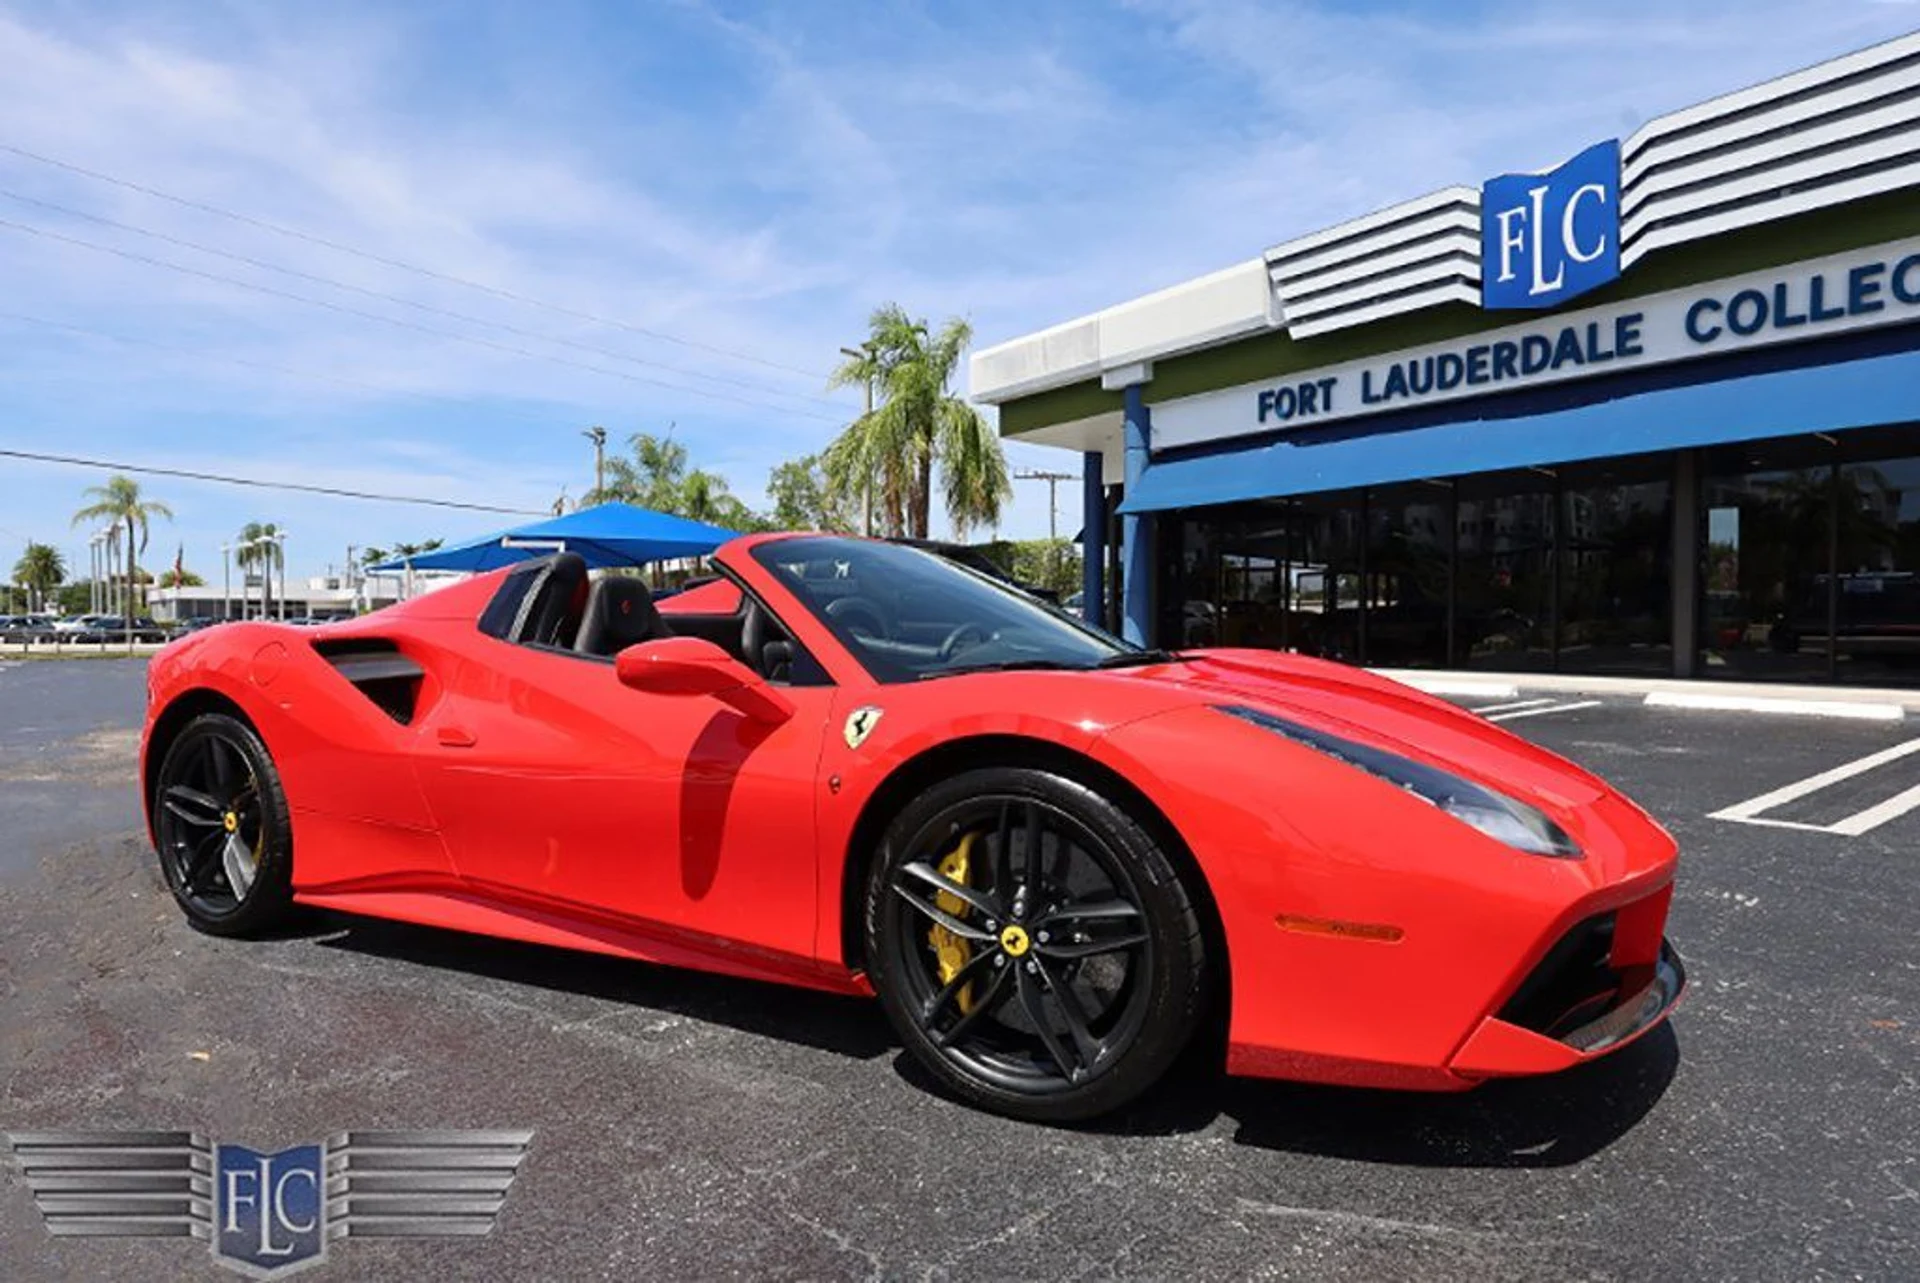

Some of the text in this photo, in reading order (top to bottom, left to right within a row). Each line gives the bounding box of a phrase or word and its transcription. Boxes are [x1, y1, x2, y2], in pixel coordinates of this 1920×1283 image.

[1496, 184, 1606, 296] FLC
[1258, 377, 1338, 423] FORT
[1361, 312, 1645, 404] LAUDERDALE
